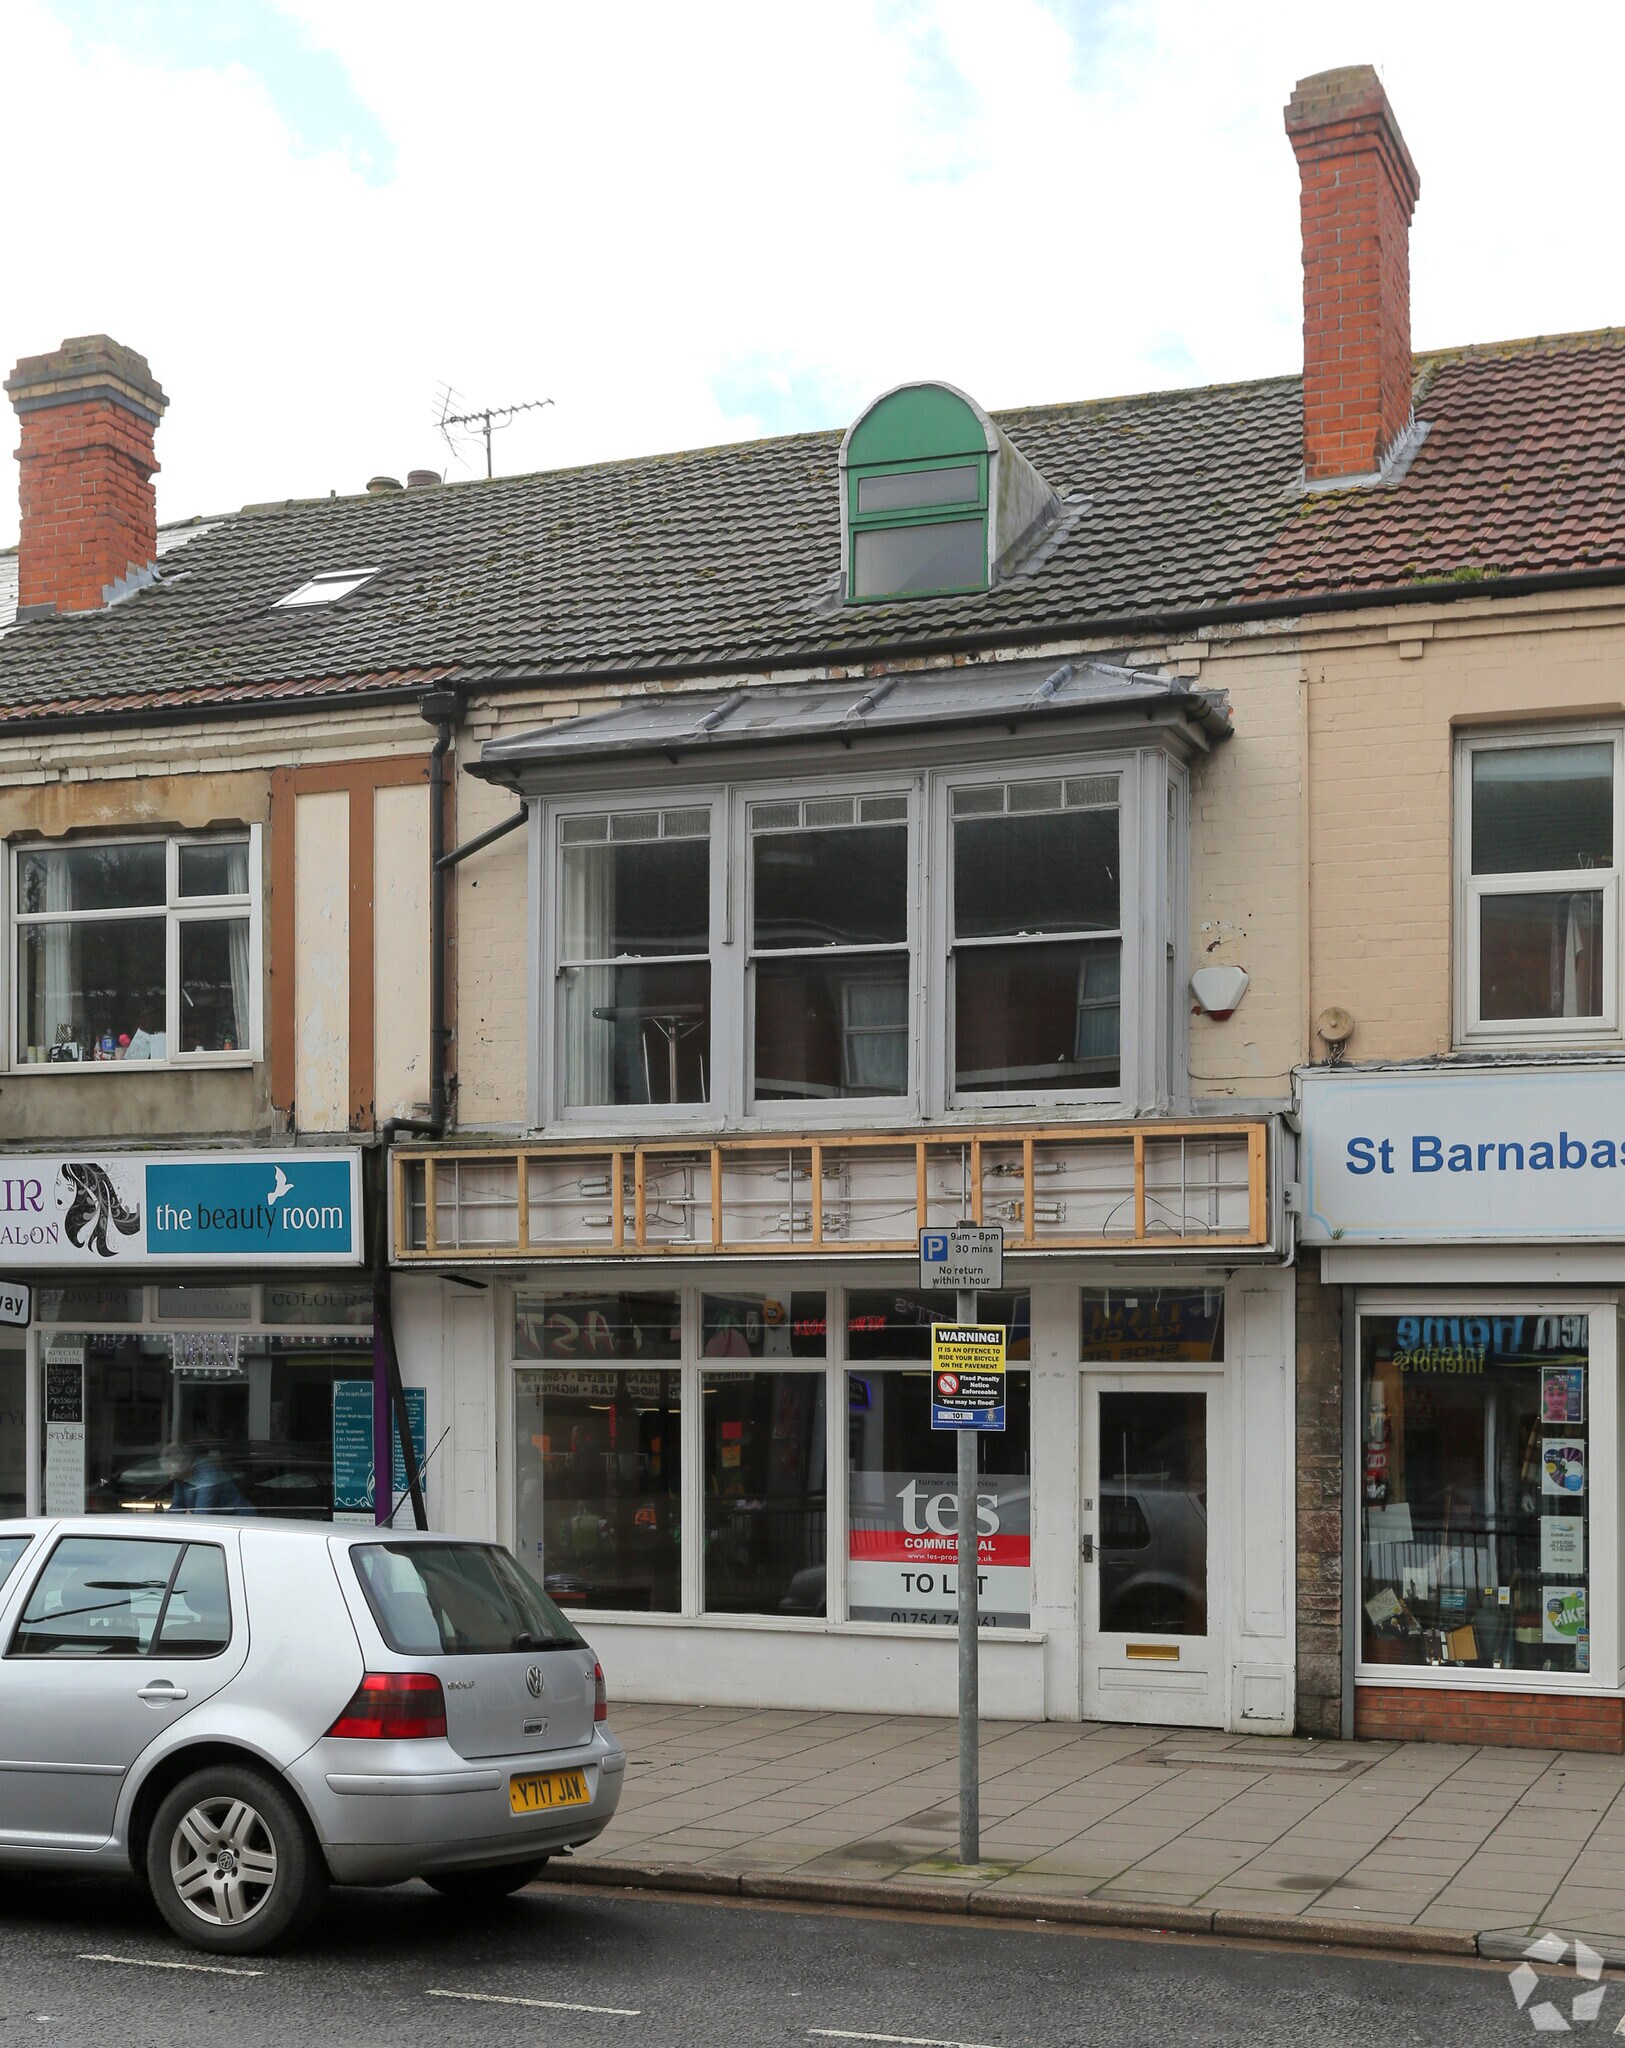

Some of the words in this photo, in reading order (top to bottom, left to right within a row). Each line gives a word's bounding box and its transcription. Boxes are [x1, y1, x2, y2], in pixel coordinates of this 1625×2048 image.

[1346, 1137, 1395, 1174] St
[1412, 1132, 1625, 1172] Barnaba
[156, 1203, 192, 1231] the
[197, 1202, 277, 1239] beauty
[283, 1207, 343, 1230] room
[951, 1232, 970, 1241] 9am
[979, 1232, 999, 1241] 8pm
[956, 1245, 969, 1253] 30
[972, 1245, 993, 1253] mins
[939, 1266, 952, 1275] No
[955, 1266, 983, 1275] return
[938, 1331, 999, 1343] WARNING!
[896, 1479, 1000, 1537] tes
[904, 1538, 997, 1551] COMMEAL
[901, 1573, 934, 1593] TO
[943, 1574, 988, 1595] LT
